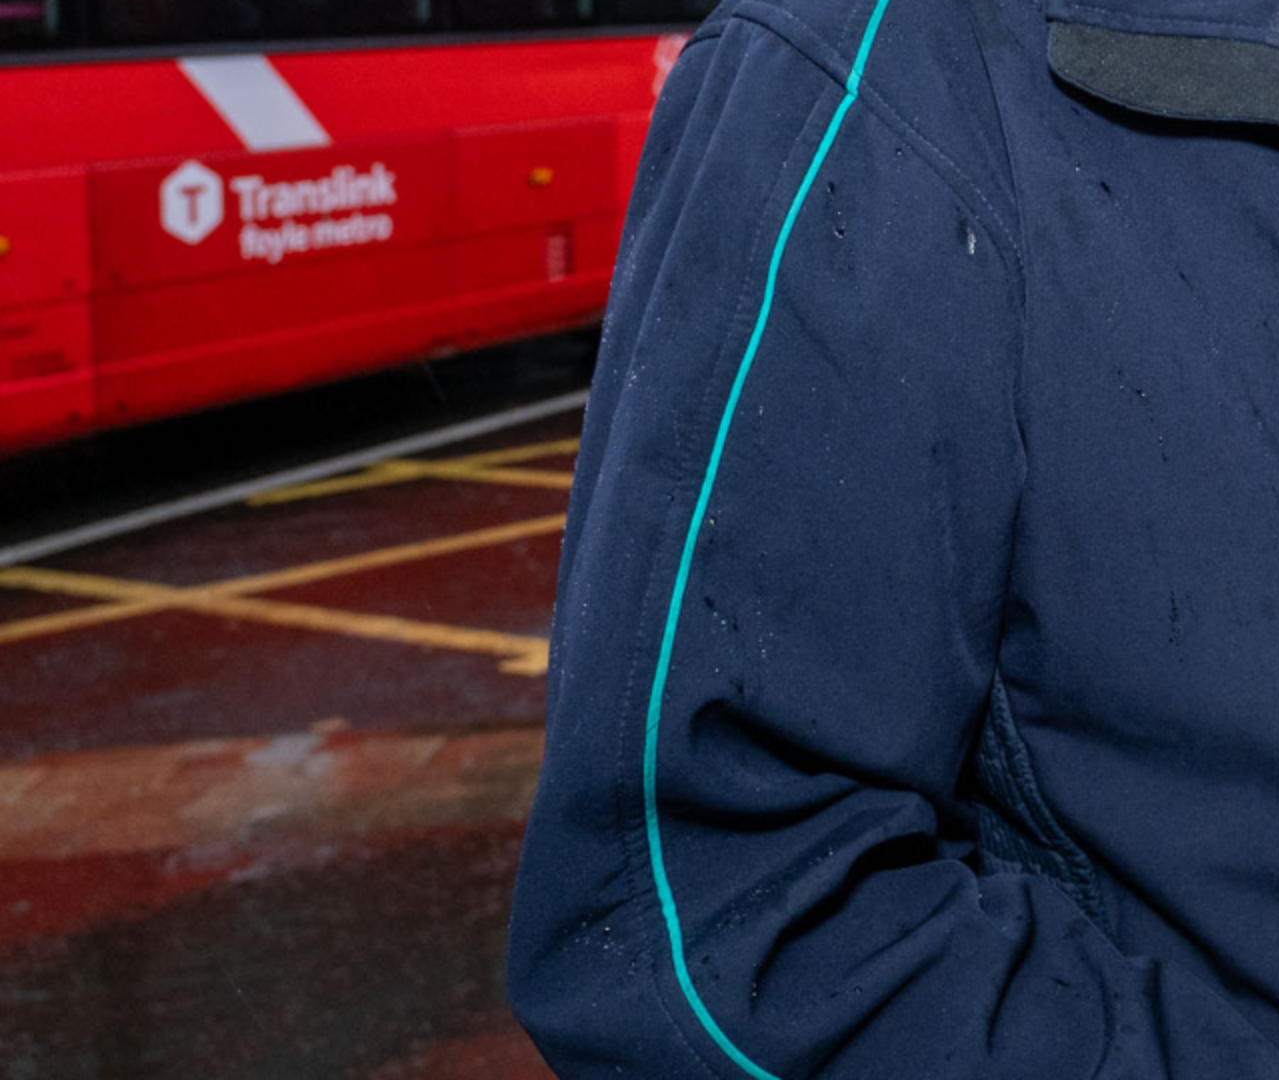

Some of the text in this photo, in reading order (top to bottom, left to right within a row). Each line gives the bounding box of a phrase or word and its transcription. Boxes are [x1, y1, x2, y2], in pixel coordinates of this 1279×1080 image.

[229, 161, 398, 222] Translink
[239, 210, 394, 265] foyle metro
